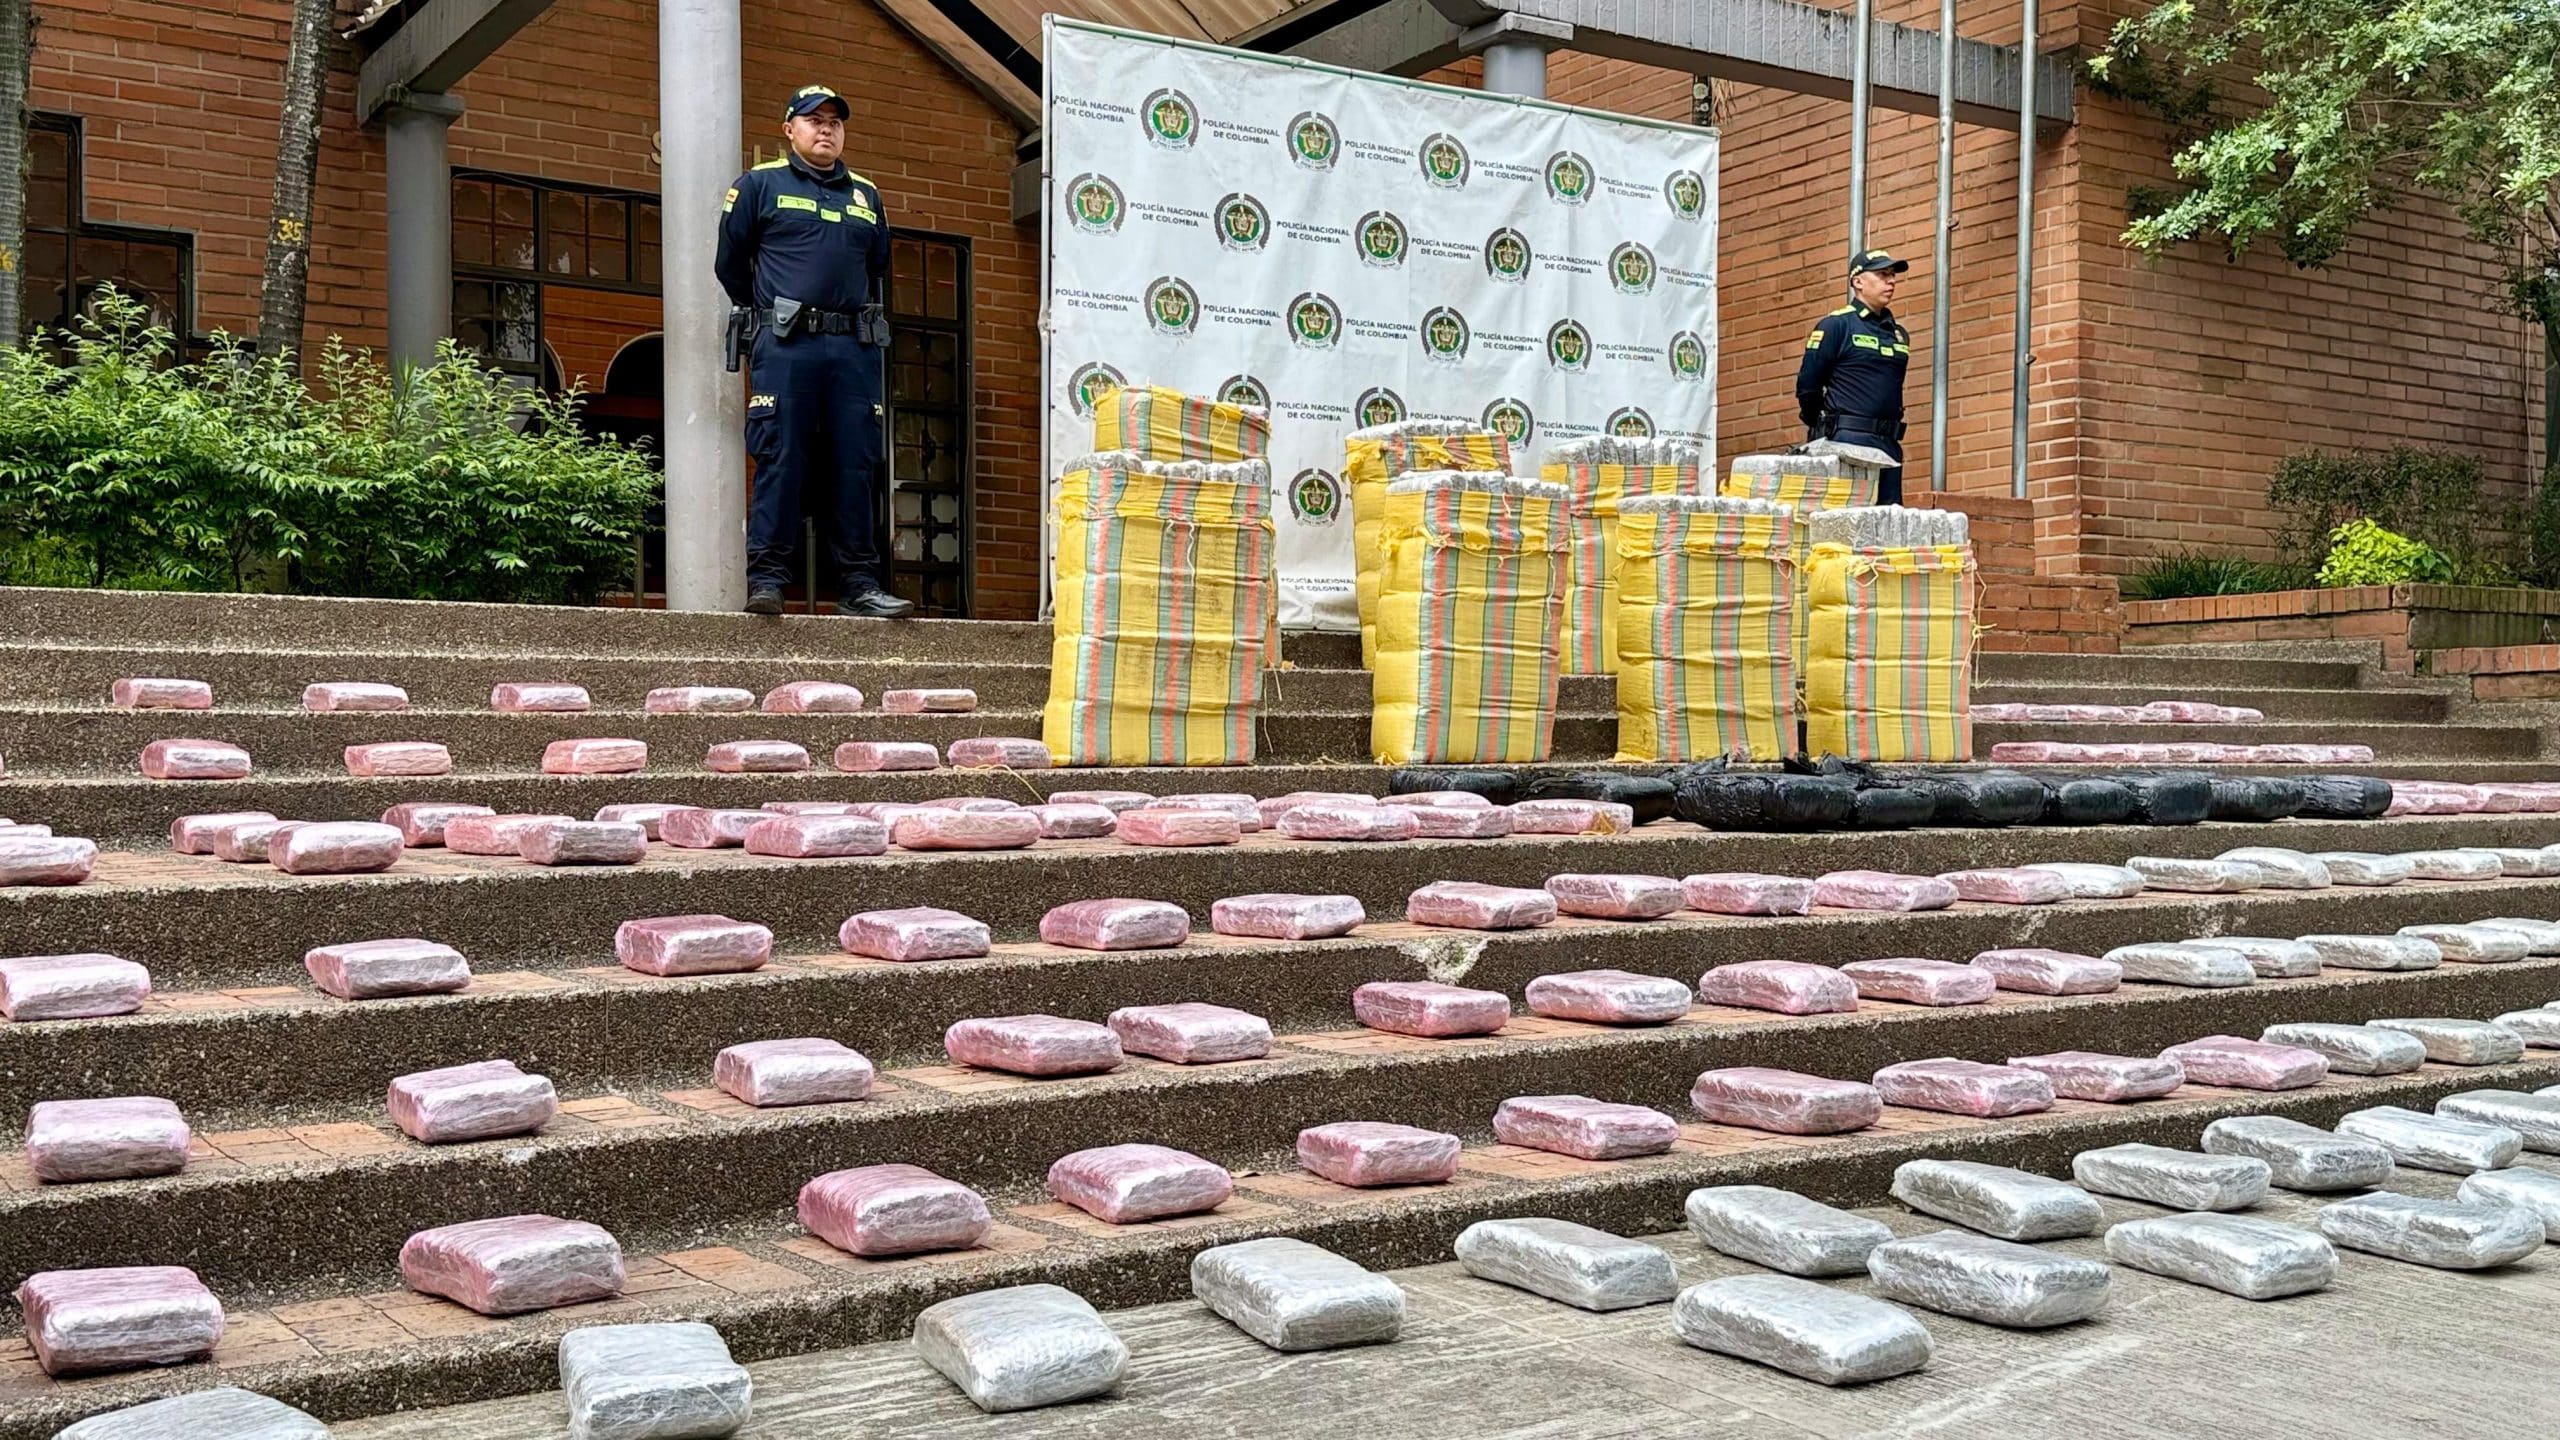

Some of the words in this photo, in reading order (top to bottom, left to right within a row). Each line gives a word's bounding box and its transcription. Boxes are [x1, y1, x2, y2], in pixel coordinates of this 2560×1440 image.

[1055, 95, 1087, 107] POLICÍA
[1090, 102, 1136, 115] NACIONAL
[1066, 107, 1076, 115] DE
[1079, 110, 1124, 123] COLOMBIA
[1203, 119, 1235, 131] POLICÍA
[1236, 125, 1280, 137] NACIONAL
[1214, 130, 1224, 139] DE
[1226, 132, 1269, 144] COLOMBIA
[1345, 141, 1375, 151] POLICÍA
[1378, 146, 1415, 158] NACIONAL
[1355, 151, 1364, 159] DE
[1367, 153, 1406, 164] COLOMBIA
[1474, 160, 1504, 169] POLICÍA
[1506, 164, 1541, 175] NACIONAL
[1496, 172, 1533, 182] COLOMBIA
[1130, 202, 1164, 213] POLICÍA
[1167, 208, 1209, 219] NACIONAL
[1142, 213, 1153, 221] DE
[1156, 215, 1198, 227] COLOMBIA
[278, 219, 304, 241] 35
[1277, 221, 1307, 231] POLICÍA
[1309, 225, 1350, 236] NACIONAL
[1299, 233, 1340, 244] COLOMBIA
[1412, 238, 1440, 247] POLICÍA
[1442, 242, 1480, 252] NACIONAL
[1421, 248, 1431, 256] DE
[1432, 250, 1471, 260] COLOMBIA
[1535, 254, 1564, 263] POLICÍA
[1566, 257, 1602, 267] NACIONAL
[1556, 264, 1592, 275] COLOMBIA
[1056, 289, 1090, 299] POLICÍA
[1092, 293, 1139, 303] NACIONAL
[1068, 299, 1079, 307] DE
[1082, 301, 1128, 311] COLOMBIA
[1204, 304, 1236, 314] POLICÍA
[1239, 308, 1281, 318] NACIONAL
[1227, 316, 1271, 326] COLOMBIA
[1346, 319, 1375, 327] POLICÍA
[1377, 322, 1416, 331] NACIONAL
[1367, 331, 1408, 340] COLOMBIA
[1474, 332, 1502, 341] POLICÍA
[1504, 335, 1543, 343] NACIONAL
[1494, 343, 1533, 351] COLOMBIA
[1277, 402, 1308, 411] POLICÍA
[1311, 404, 1350, 413] NACIONAL
[1300, 412, 1341, 421] COLOMBIA
[1537, 421, 1563, 429] POLICÍA
[1565, 424, 1600, 432] NACIONAL
